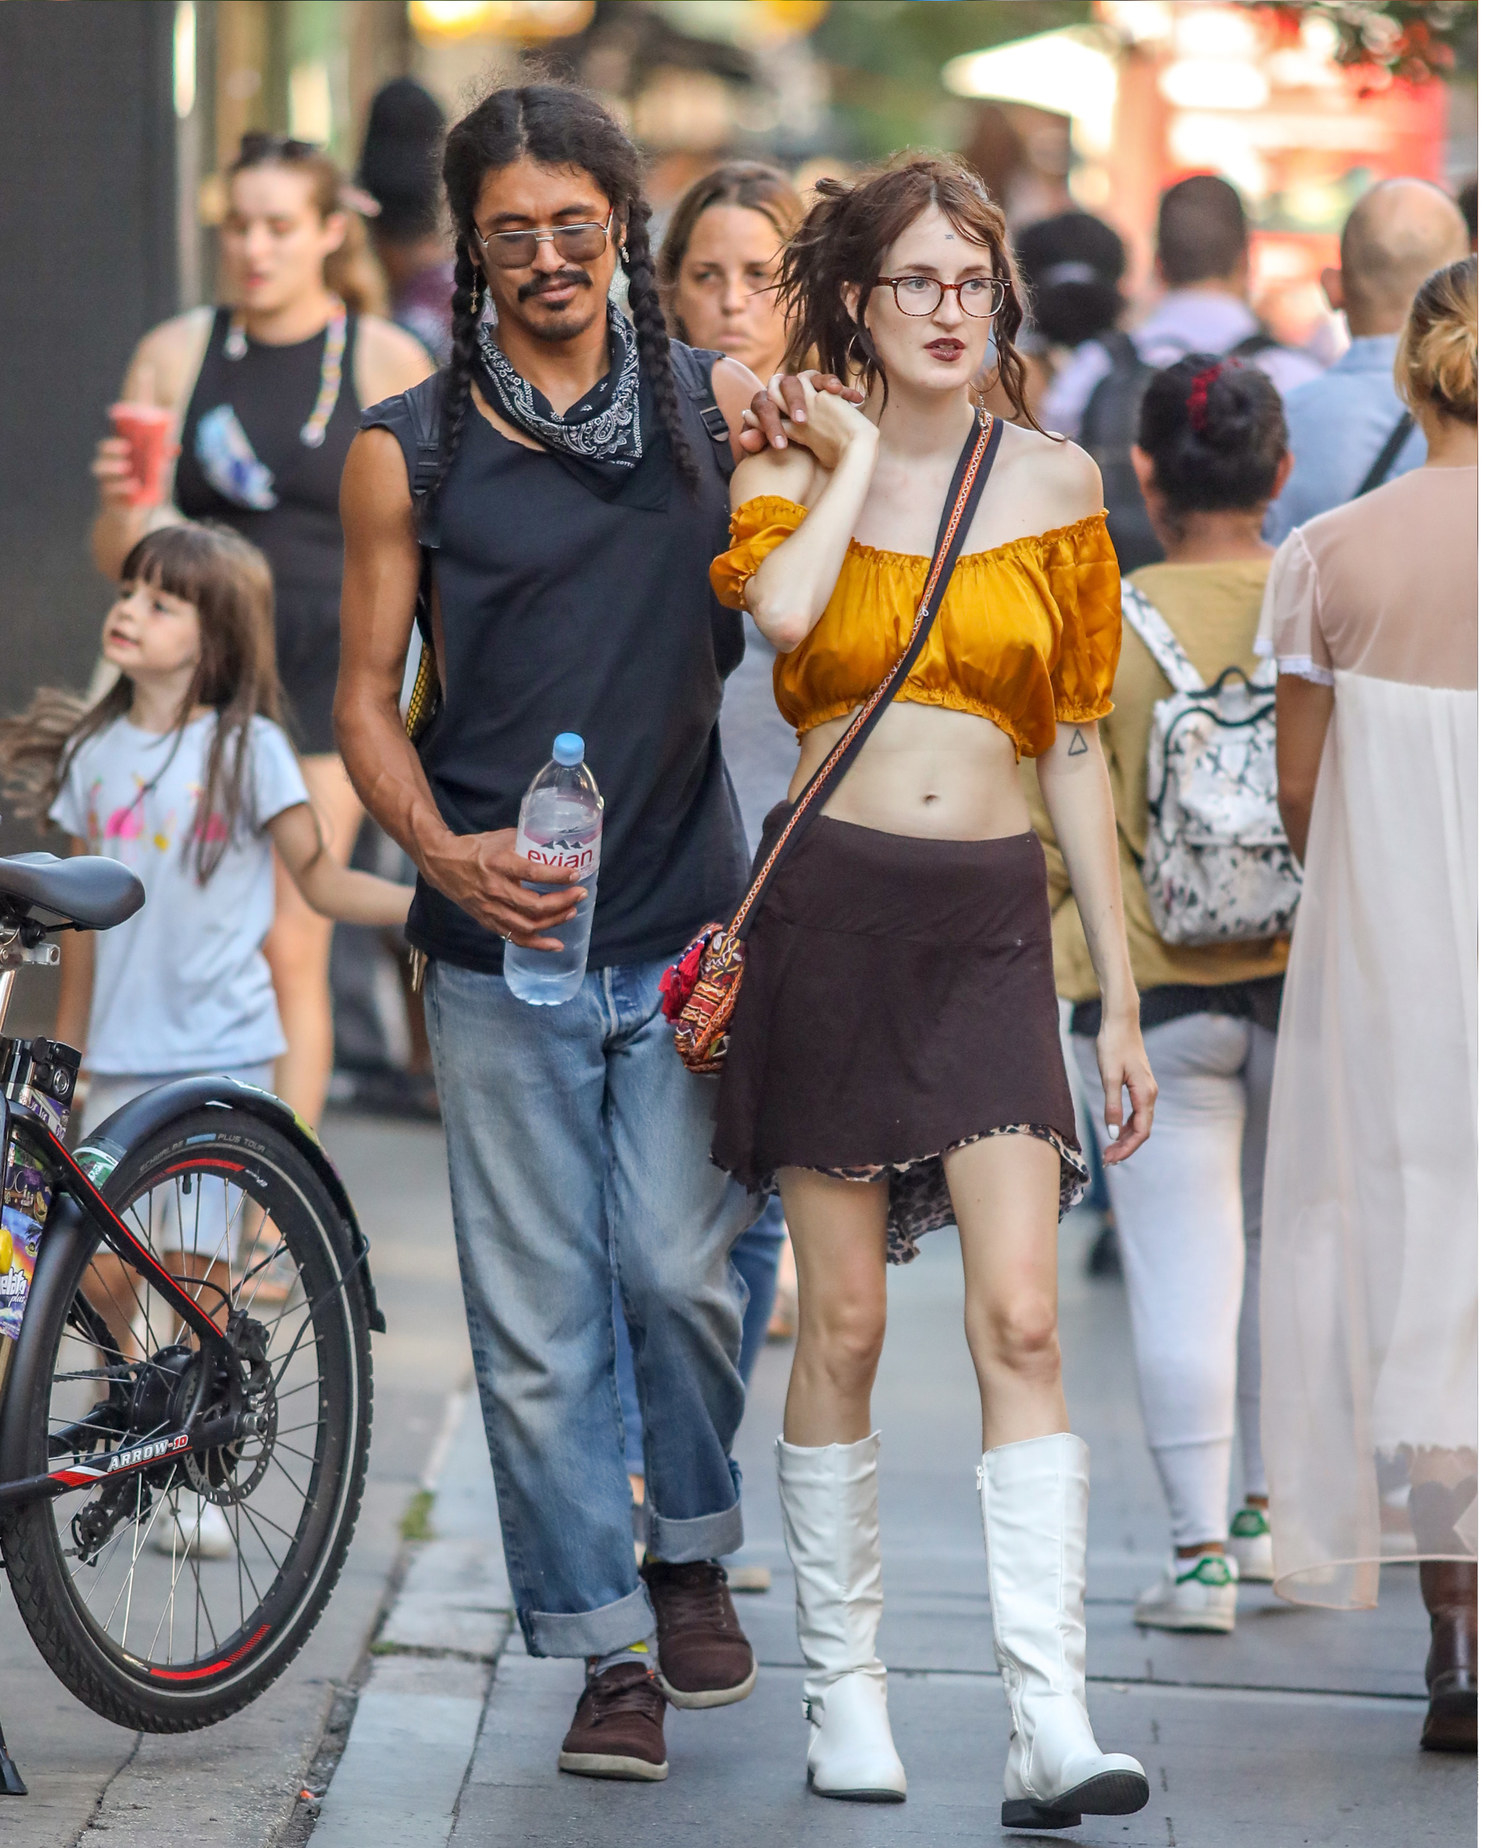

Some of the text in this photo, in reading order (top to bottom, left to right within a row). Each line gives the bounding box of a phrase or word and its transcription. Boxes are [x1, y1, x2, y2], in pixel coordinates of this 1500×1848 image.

[527, 849, 593, 868] evian
[217, 1133, 241, 1143] PLUS
[244, 1137, 266, 1152] TOUR
[107, 1434, 189, 1473] ARROW-10
